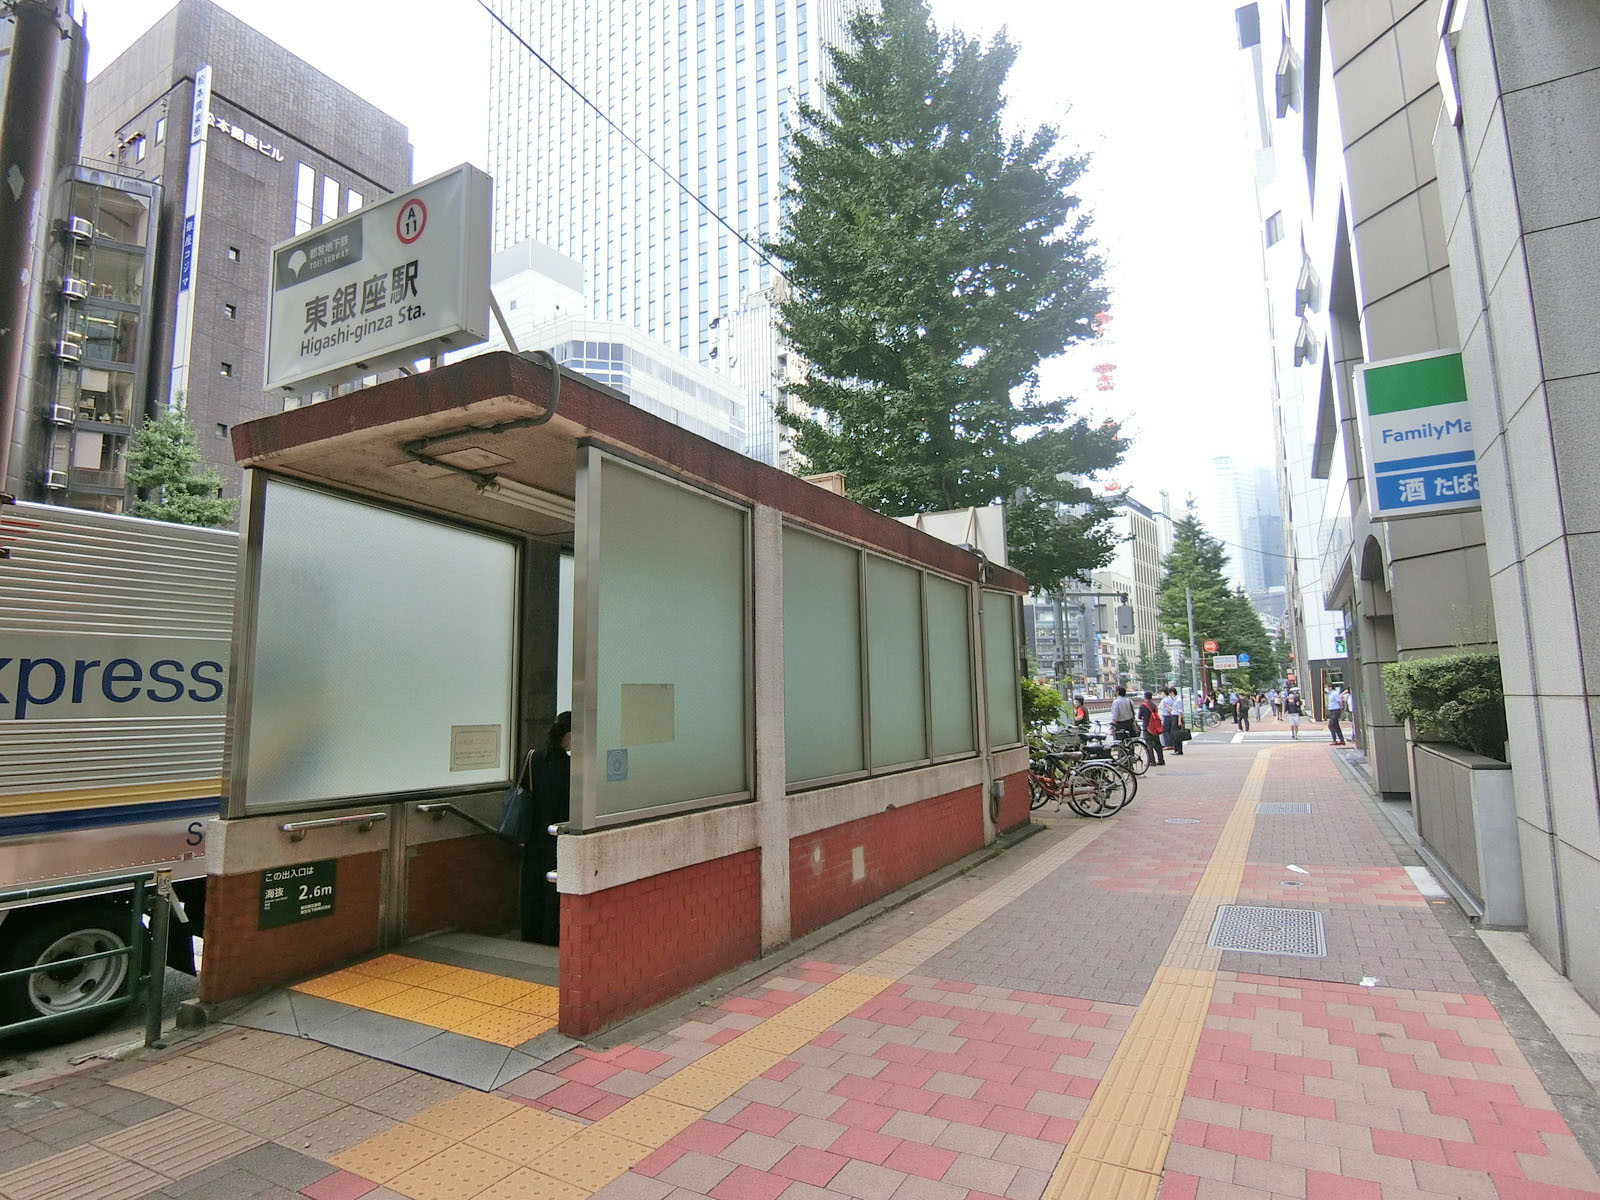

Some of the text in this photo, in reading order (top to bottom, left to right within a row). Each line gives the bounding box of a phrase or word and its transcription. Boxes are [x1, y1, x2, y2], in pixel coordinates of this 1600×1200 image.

[407, 207, 416, 220] A
[405, 220, 417, 235] 11
[324, 249, 350, 266] SUBWAY
[303, 259, 419, 335] 東銀座駅
[300, 305, 426, 357] Higashi-ginza Sta.
[1382, 418, 1472, 444] FamilyMa
[1398, 477, 1426, 502] 酒
[265, 866, 314, 883] この出入口は
[264, 887, 285, 900] 海抜
[298, 884, 332, 900] 2.6m
